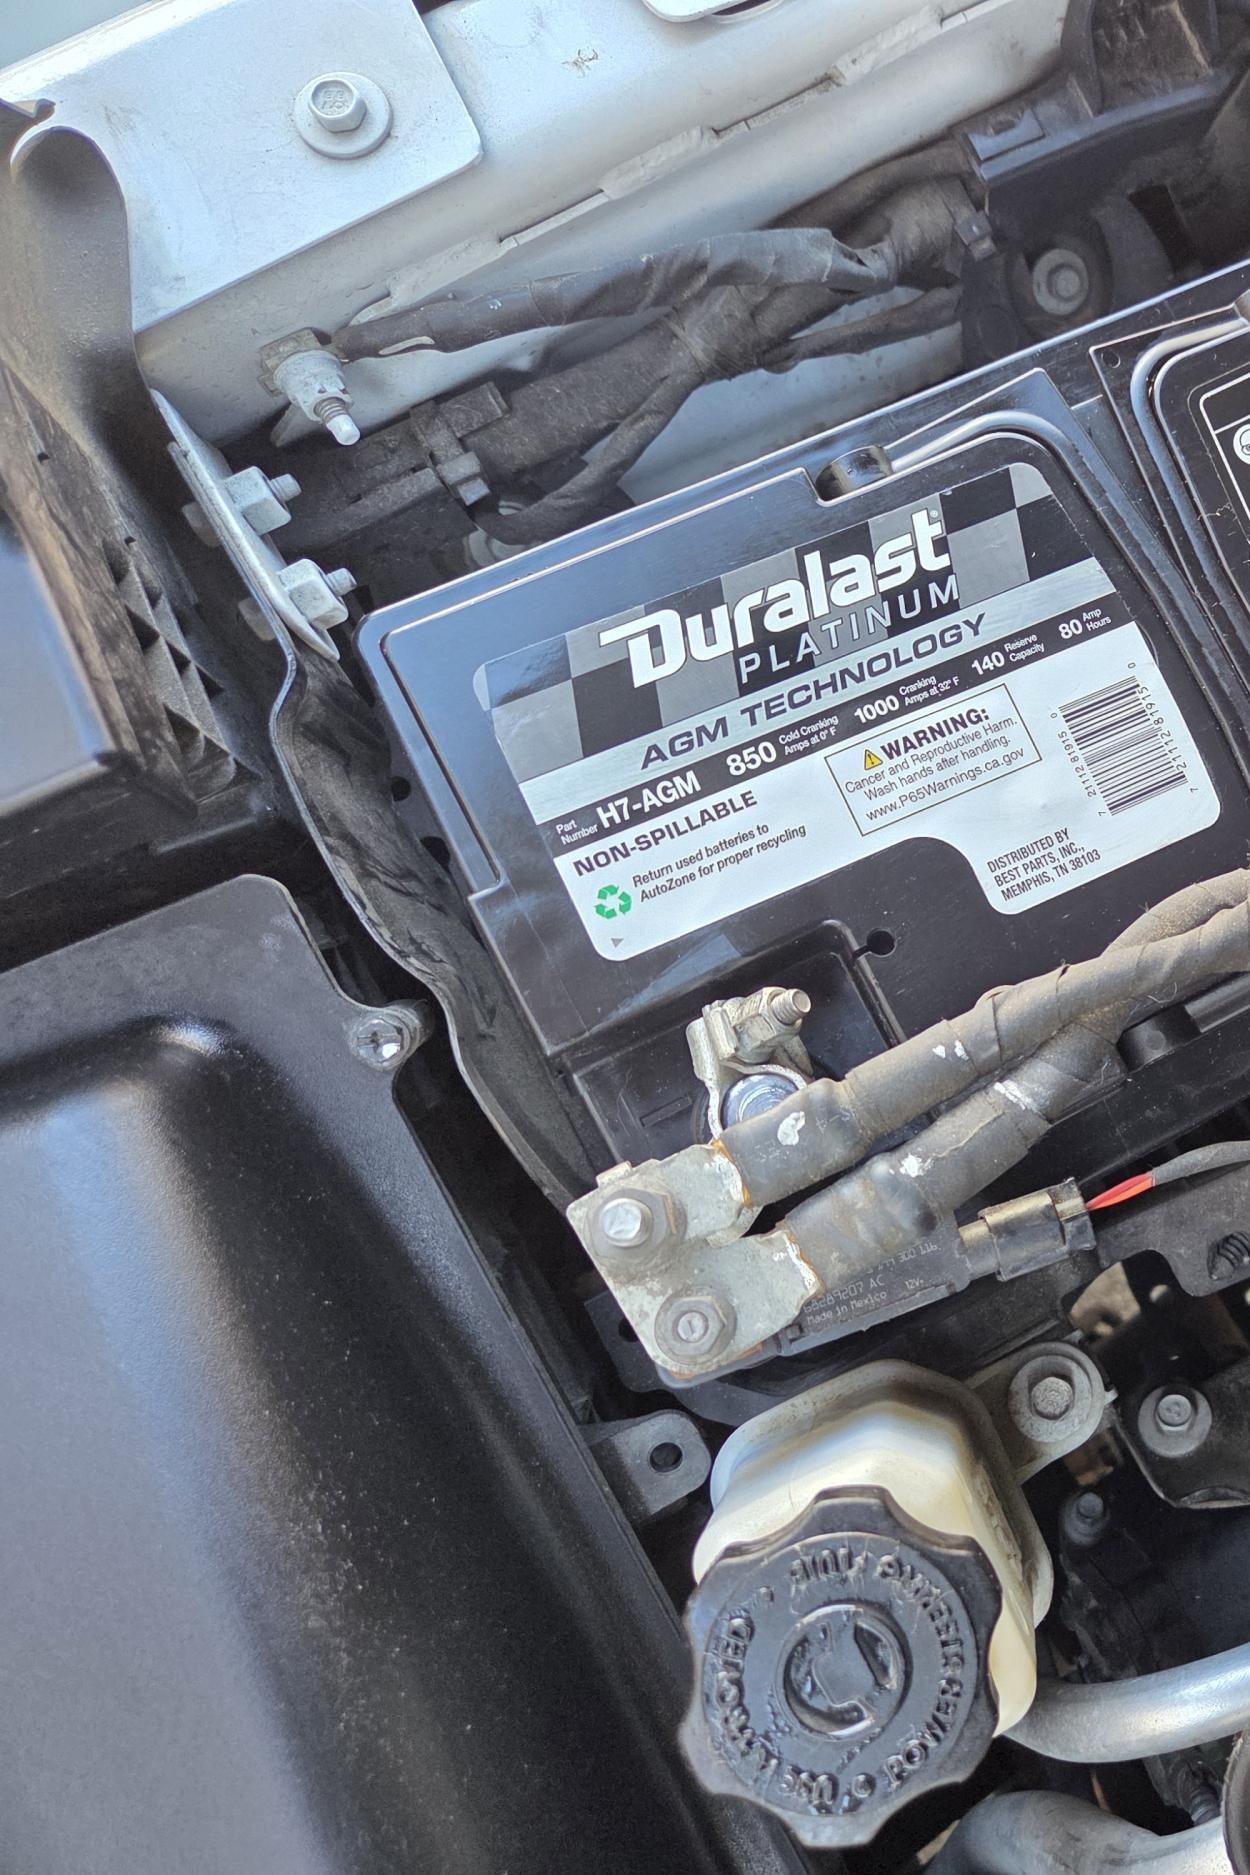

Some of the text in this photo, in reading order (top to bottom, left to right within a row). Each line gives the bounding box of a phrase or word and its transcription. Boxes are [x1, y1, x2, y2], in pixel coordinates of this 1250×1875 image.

[738, 574, 960, 684] PLATINUM
[1058, 619, 1082, 638] 80
[1082, 608, 1101, 625] Amp
[1085, 616, 1111, 631] Hours
[1003, 634, 1037, 652] Reserve
[1009, 642, 1044, 661] Capacity
[971, 651, 1004, 674] 140
[640, 612, 985, 770] AGM TECHNOLOGY
[898, 675, 936, 698] Cranking
[904, 690, 929, 706] Amps
[929, 685, 939, 695] at
[952, 675, 959, 685] F
[854, 695, 899, 722] 1000
[1137, 686, 1164, 725] 81915
[778, 715, 838, 744] Cold Cranking
[784, 739, 809, 755] Amps
[809, 734, 820, 744] at
[829, 726, 836, 735] F
[879, 708, 989, 760] WARNING:
[1057, 730, 1079, 763] 81915
[726, 741, 776, 775] 850
[844, 717, 1017, 793] Cancer and Reproductive Harm.
[1160, 729, 1186, 770] 21112
[863, 735, 1010, 800] Wash hands after handling.
[865, 747, 1023, 820] www.P65Warnings.ca.gov
[1074, 764, 1096, 797] 21112
[596, 770, 701, 828] H7-AGM
[555, 819, 577, 834] Part
[560, 824, 597, 844] Number
[572, 790, 757, 876] NON-SPILLABLE
[632, 824, 768, 887] Return used batteries to
[640, 825, 806, 902] AutoZone for proper recycling
[986, 827, 1069, 872] DISTRIBUTED BY
[993, 841, 1084, 887] BEST PARTS, INC.,
[1000, 848, 1100, 901] MEMPHIS, TN 38103
[869, 1273, 884, 1288] AC
[806, 1291, 887, 1325] Made in Mexico
[882, 1677, 964, 1793] POWER
